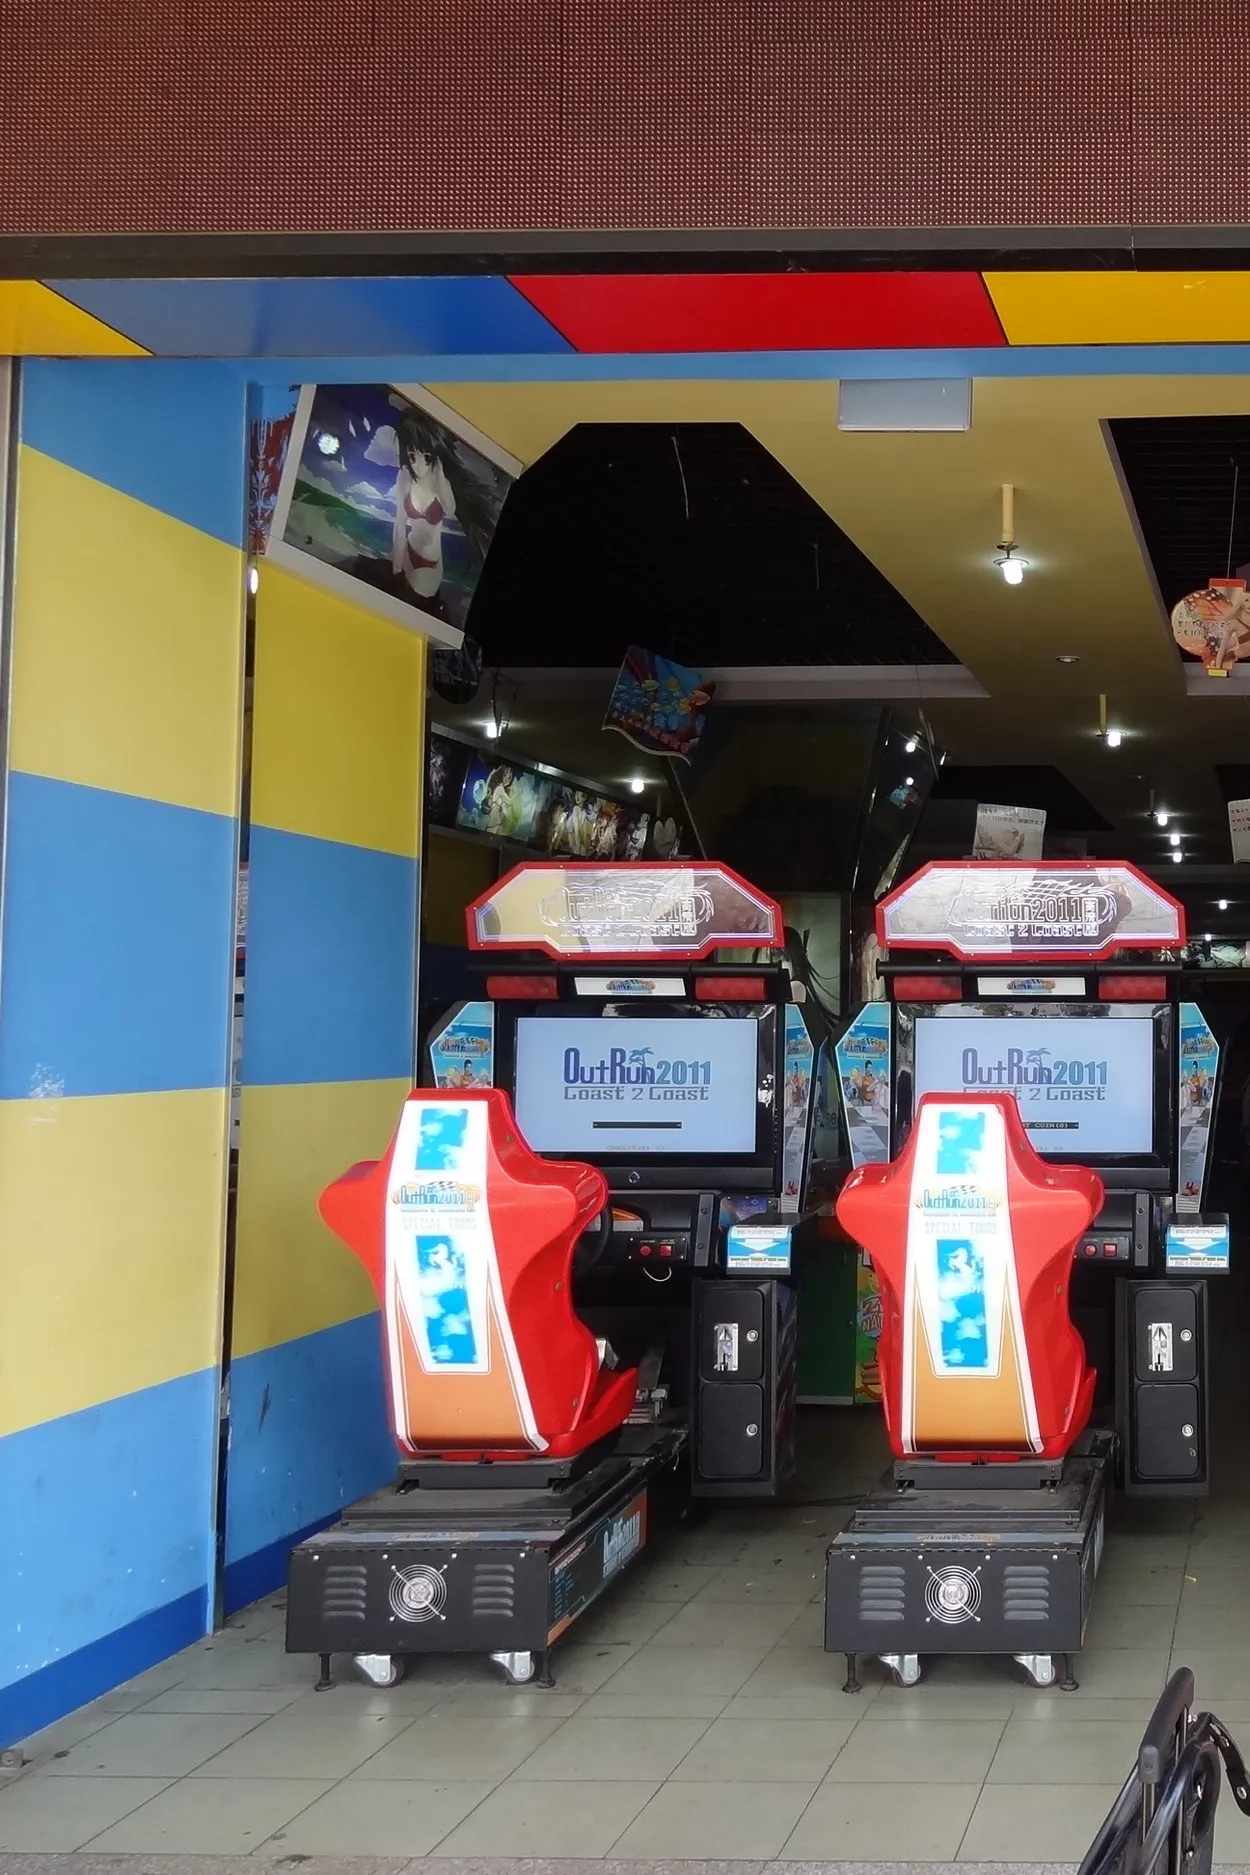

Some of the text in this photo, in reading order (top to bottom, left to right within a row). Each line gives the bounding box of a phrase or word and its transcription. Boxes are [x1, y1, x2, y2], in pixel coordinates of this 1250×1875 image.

[564, 1086, 709, 1100] Coast 2 Coast
[1029, 1088, 1041, 1100] 2
[1047, 1086, 1106, 1100] Coast
